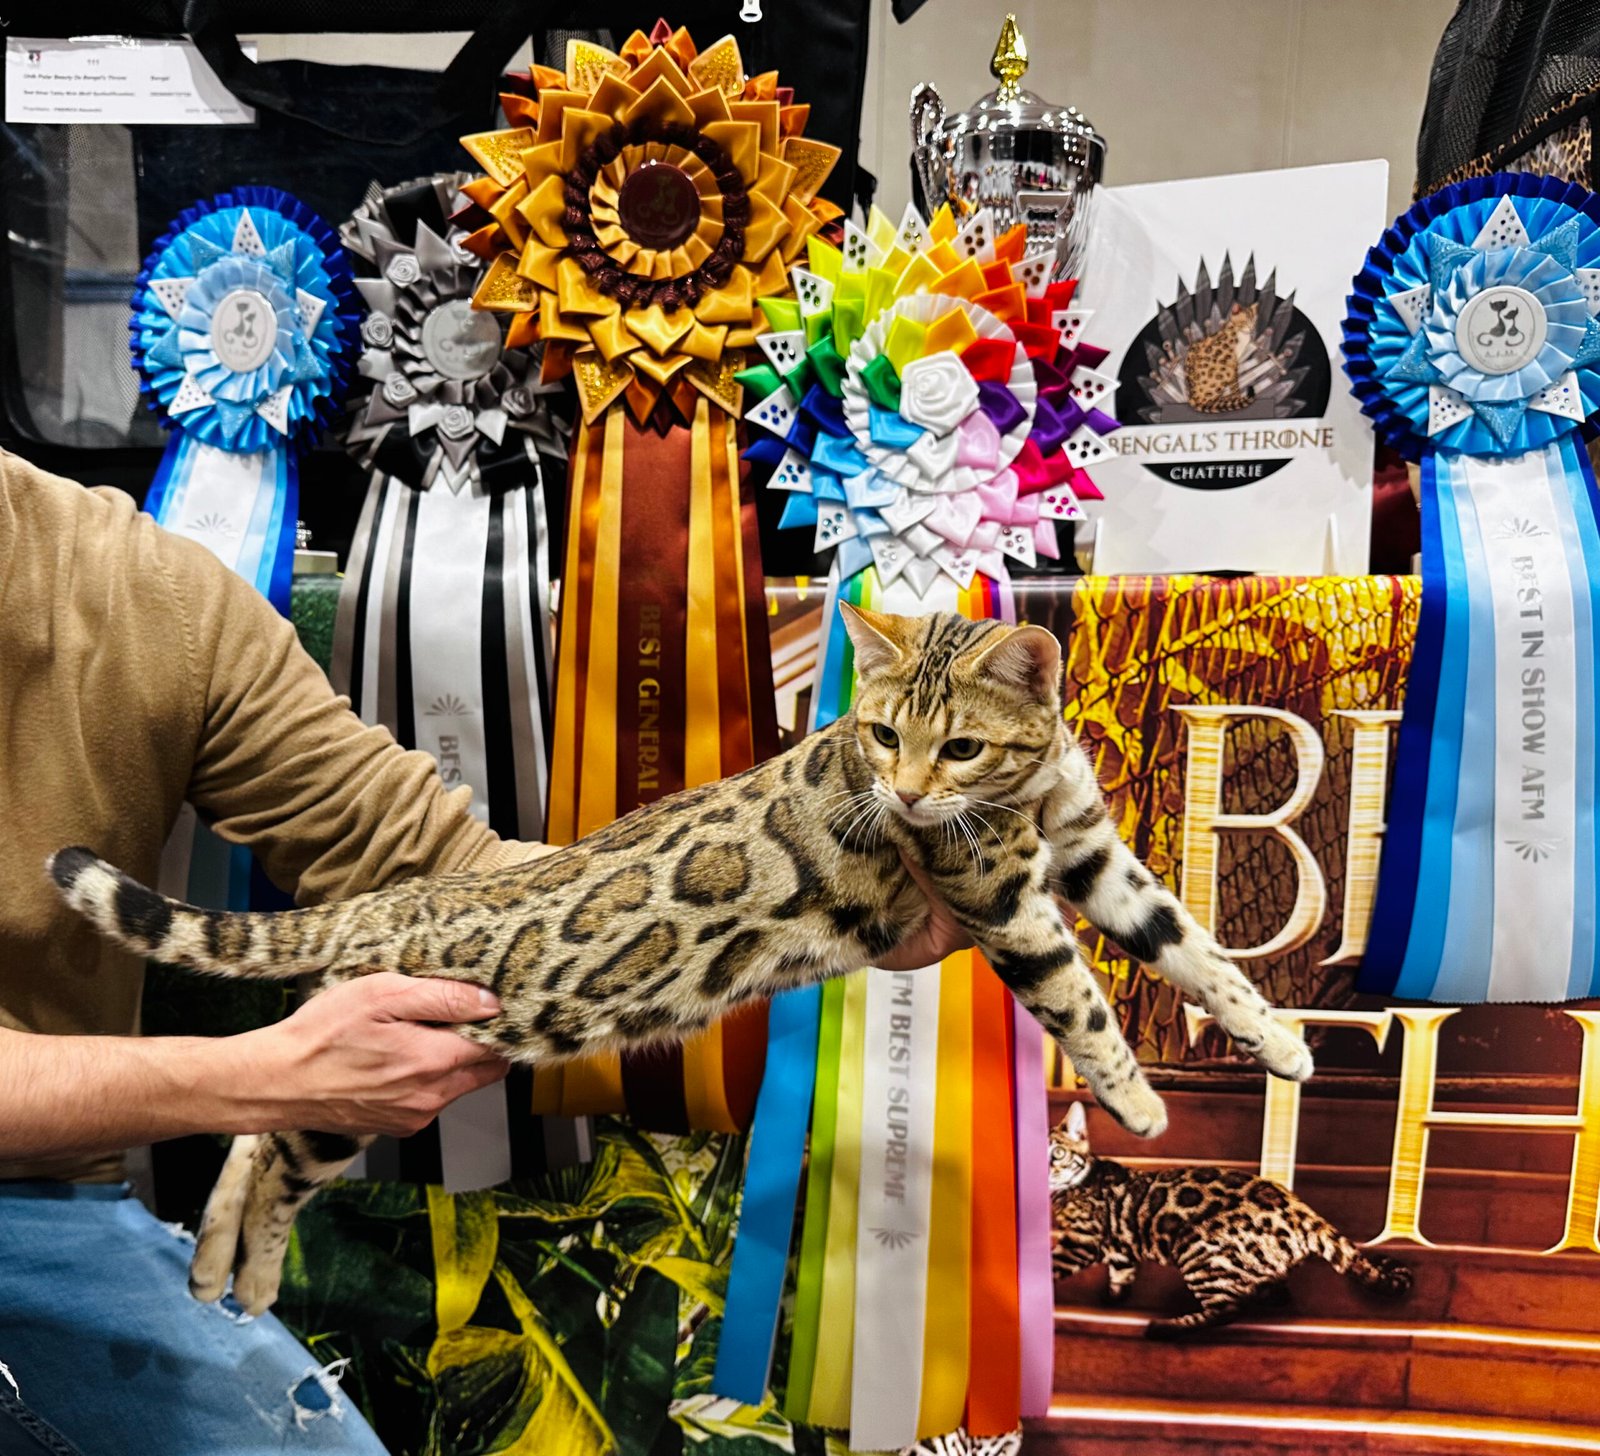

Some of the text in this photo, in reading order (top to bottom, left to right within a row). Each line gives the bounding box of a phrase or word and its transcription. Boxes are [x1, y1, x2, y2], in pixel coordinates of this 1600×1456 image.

[1108, 427, 1334, 455] BENGAL'S THRONE
[1170, 463, 1263, 480] CHATTERIE
[639, 604, 661, 669] BEST
[1511, 555, 1546, 820] BEST IN SHOW AFM
[439, 736, 462, 783] BES
[638, 677, 661, 794] GENERAL
[888, 1014, 912, 1080] BEST
